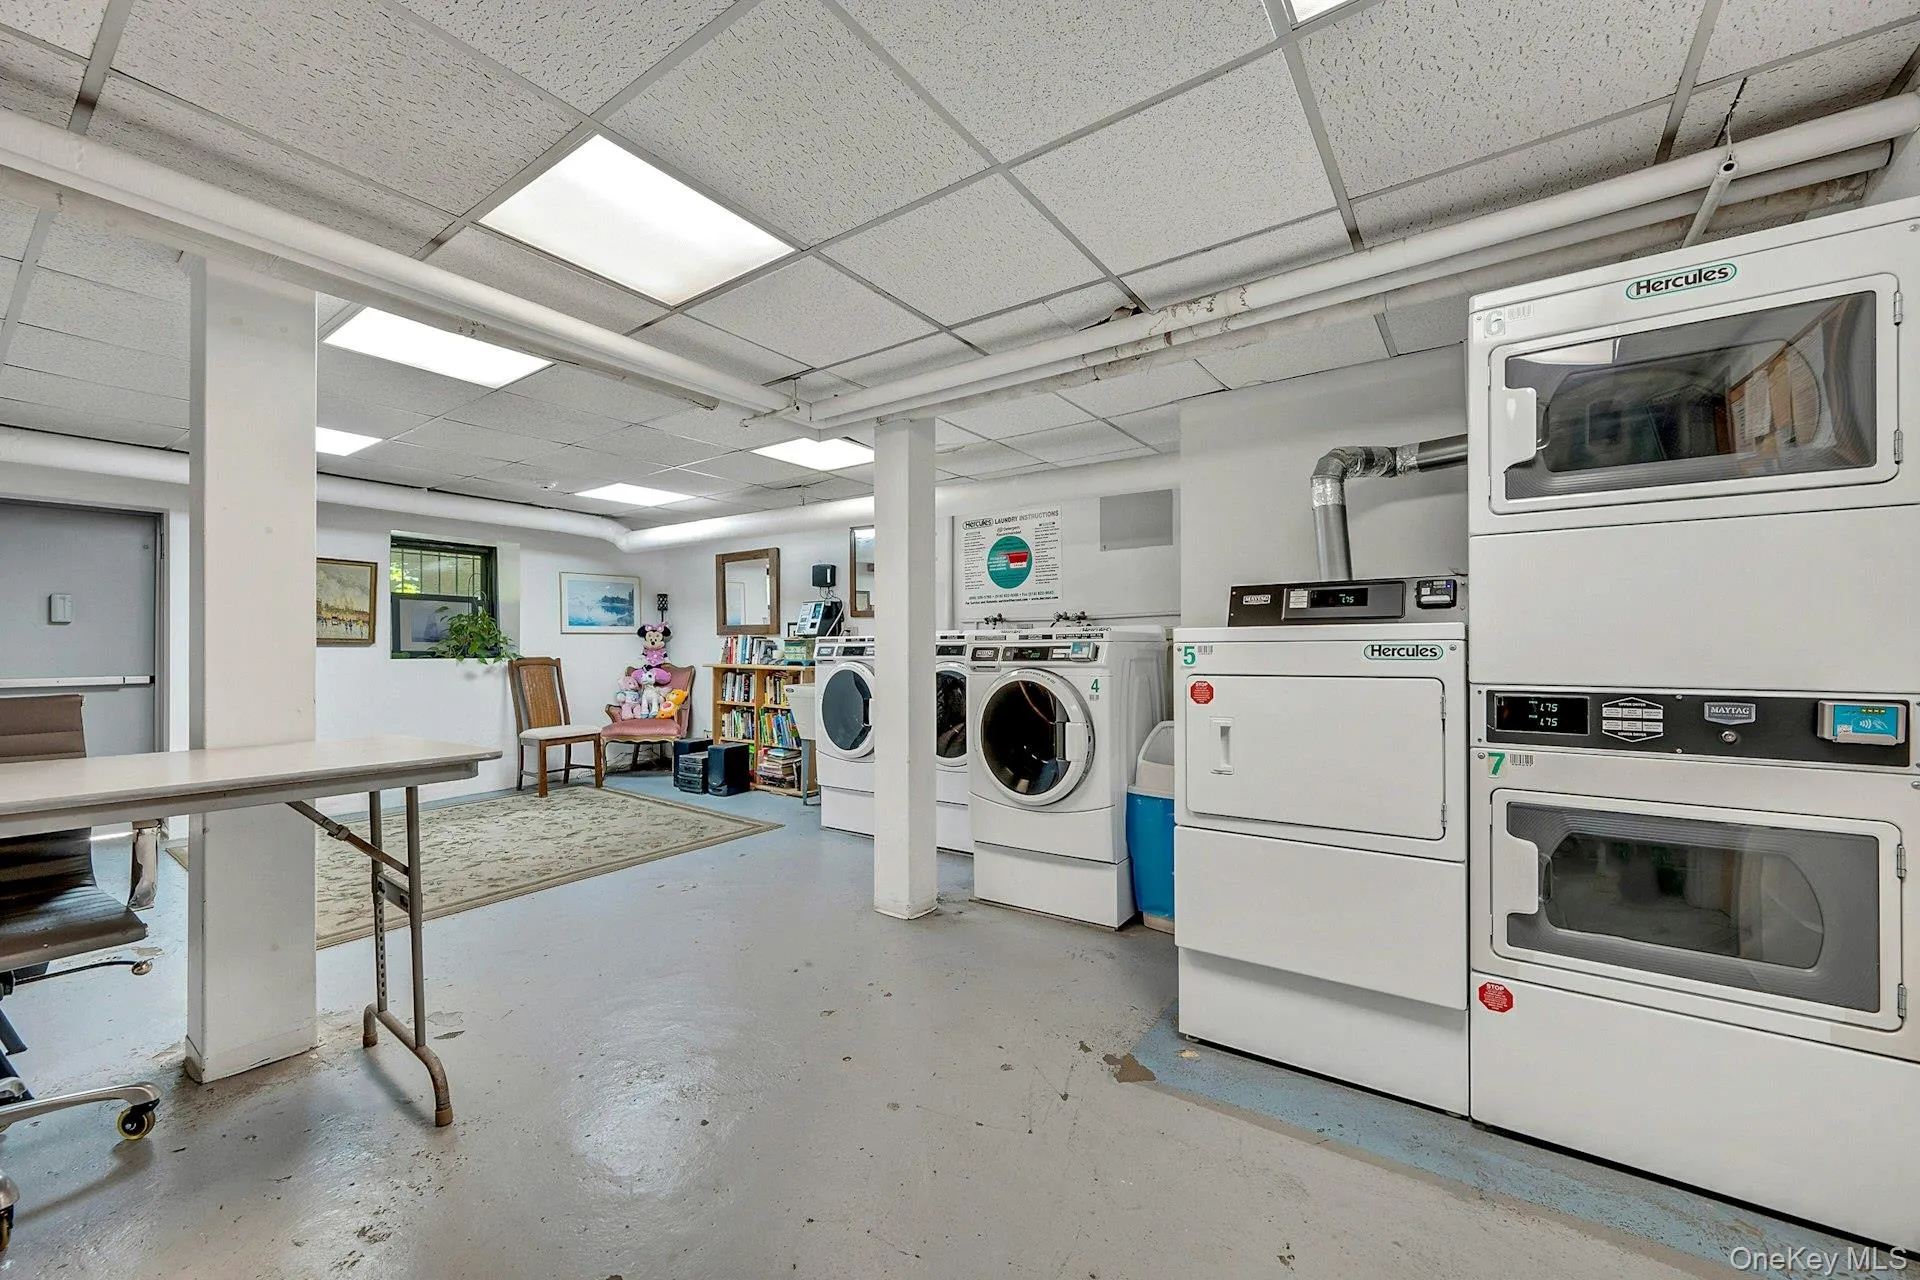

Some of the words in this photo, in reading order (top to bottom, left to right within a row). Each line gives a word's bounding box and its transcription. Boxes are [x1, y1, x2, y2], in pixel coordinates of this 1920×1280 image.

[1635, 266, 1729, 296] Hercules
[1485, 310, 1505, 336] 6
[965, 518, 992, 528] Hercules
[994, 516, 1018, 525] LAUNDRY
[1019, 510, 1059, 521] INSTRUCTIONS
[1183, 645, 1196, 665] 5
[1370, 644, 1438, 657] Hercules
[1090, 678, 1100, 693] 4
[1710, 706, 1750, 715] MAYTAG
[1487, 752, 1506, 776] 7
[1486, 983, 1505, 991] STOP
